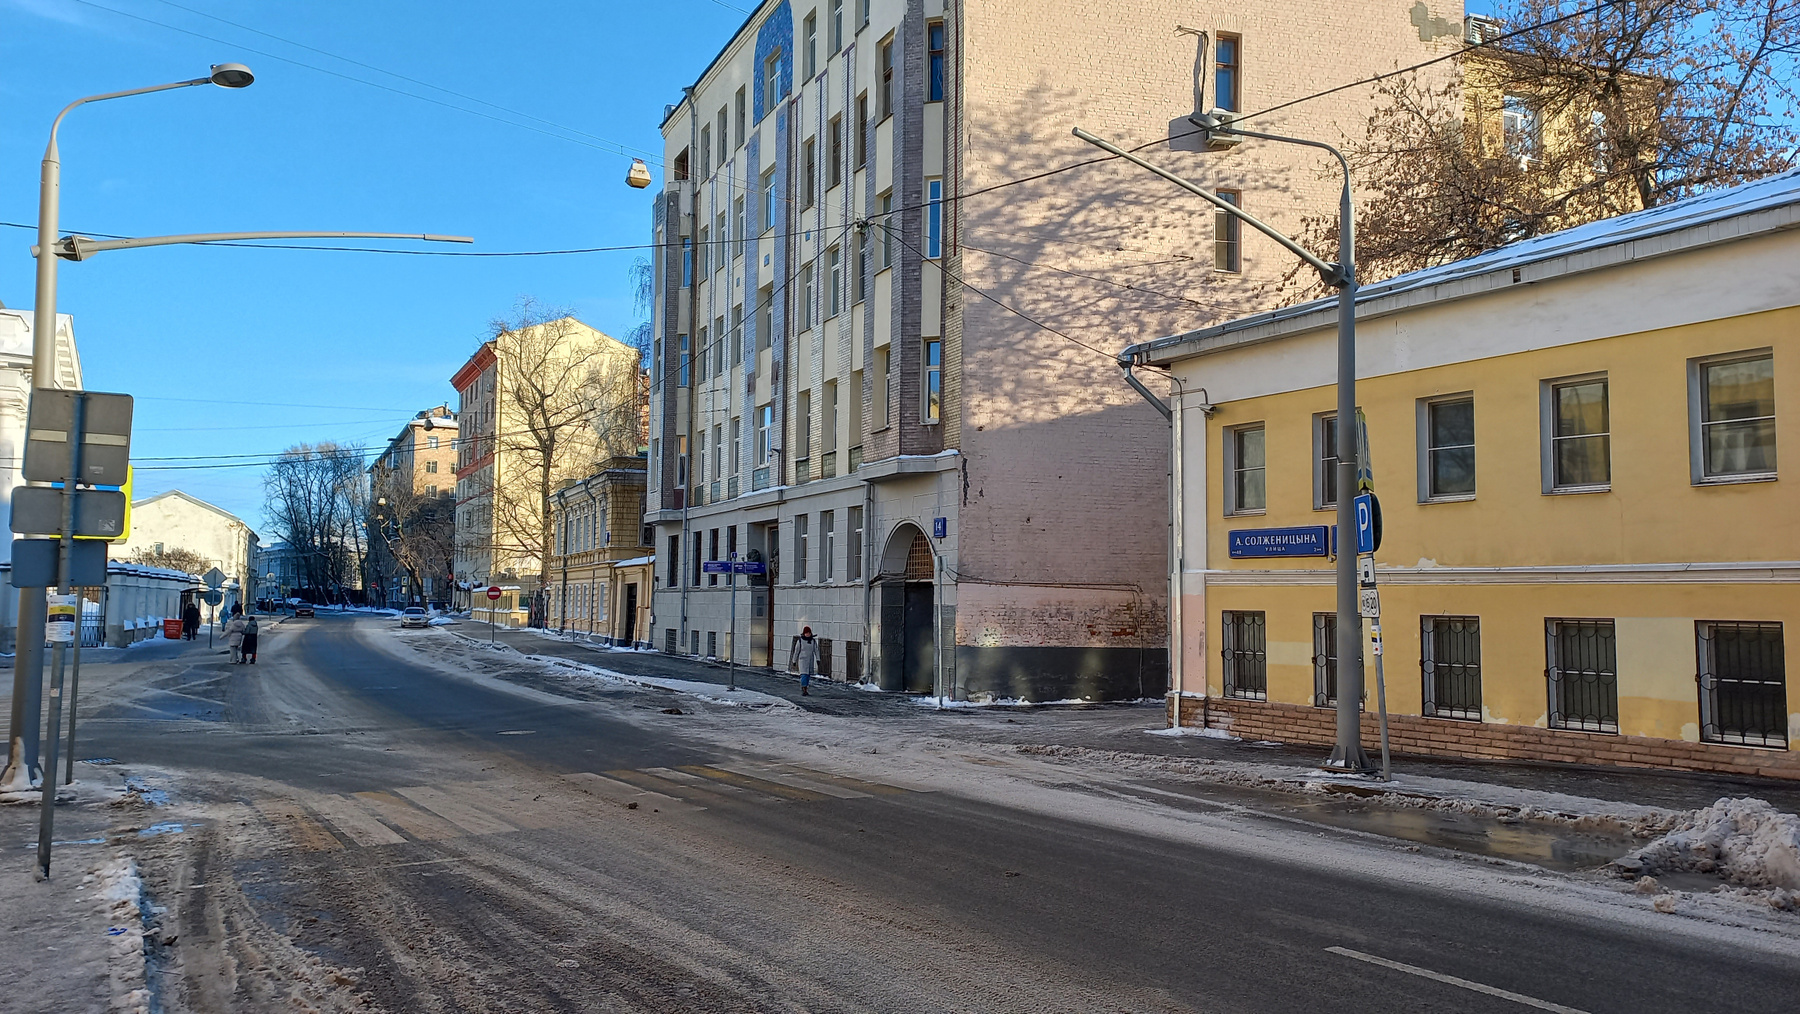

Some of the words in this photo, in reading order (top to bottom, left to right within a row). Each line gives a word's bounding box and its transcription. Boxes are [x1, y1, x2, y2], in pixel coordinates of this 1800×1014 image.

[935, 521, 941, 531] 14
[1358, 502, 1368, 547] P
[1235, 537, 1244, 546] А.
[1245, 533, 1317, 546] СОЛЖЕНИЦЫНА
